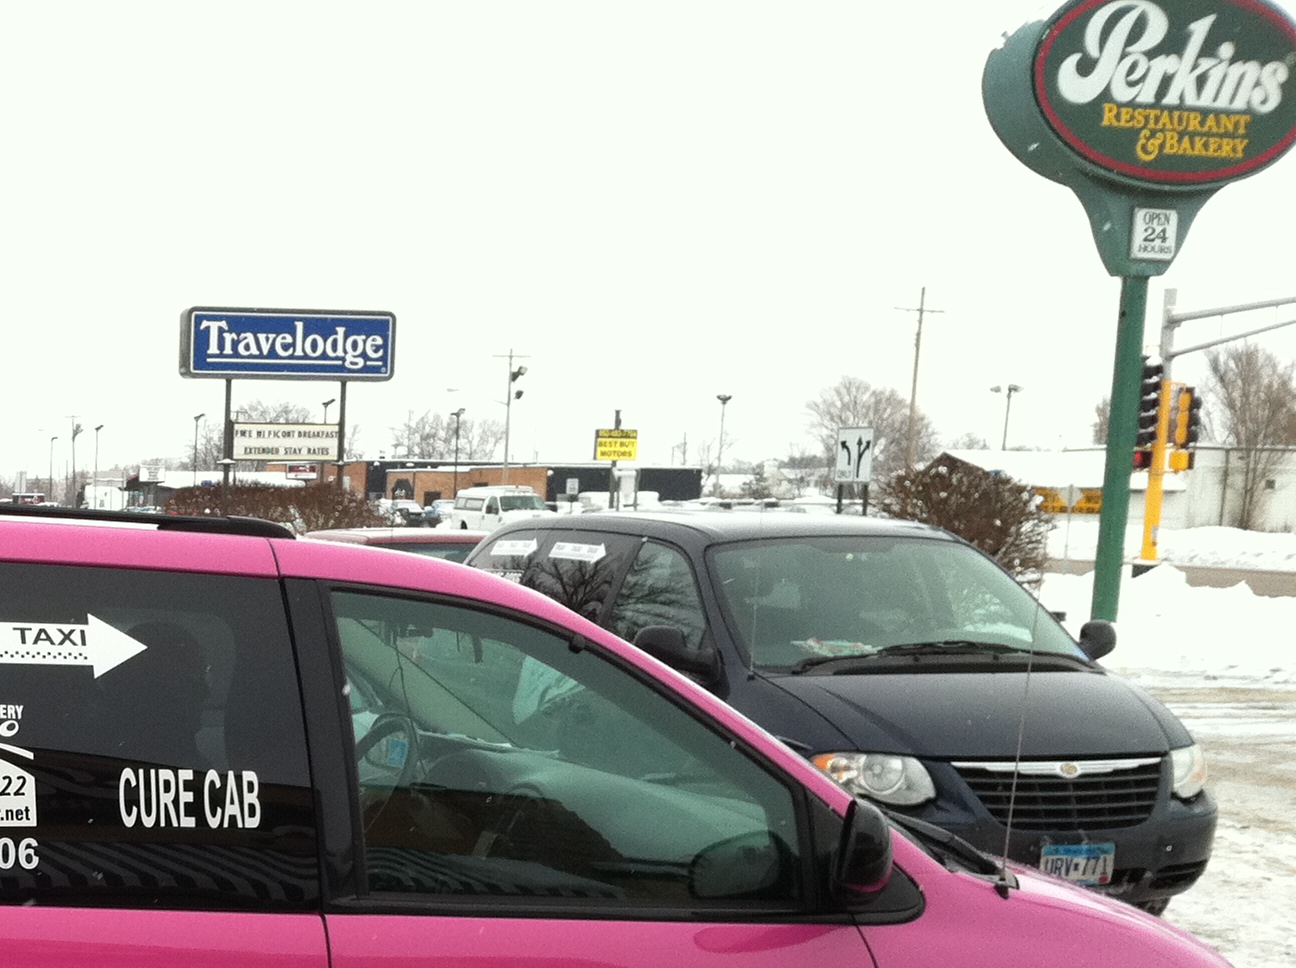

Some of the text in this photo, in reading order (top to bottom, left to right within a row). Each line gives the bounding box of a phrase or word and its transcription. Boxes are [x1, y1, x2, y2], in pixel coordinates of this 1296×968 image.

[1057, 0, 1289, 114] Perkins
[1101, 102, 1252, 134] RESTAURANT
[1143, 211, 1170, 226] OPEN
[1142, 226, 1169, 243] 24
[1137, 244, 1173, 254] HOURS
[200, 319, 384, 369] Travelodge
[235, 430, 253, 438] FREE
[297, 430, 339, 439] BREAKFAST
[244, 446, 330, 455] EXTENDED STAY RATES
[13, 626, 88, 647] TAXI
[119, 767, 262, 829] CURE CAB
